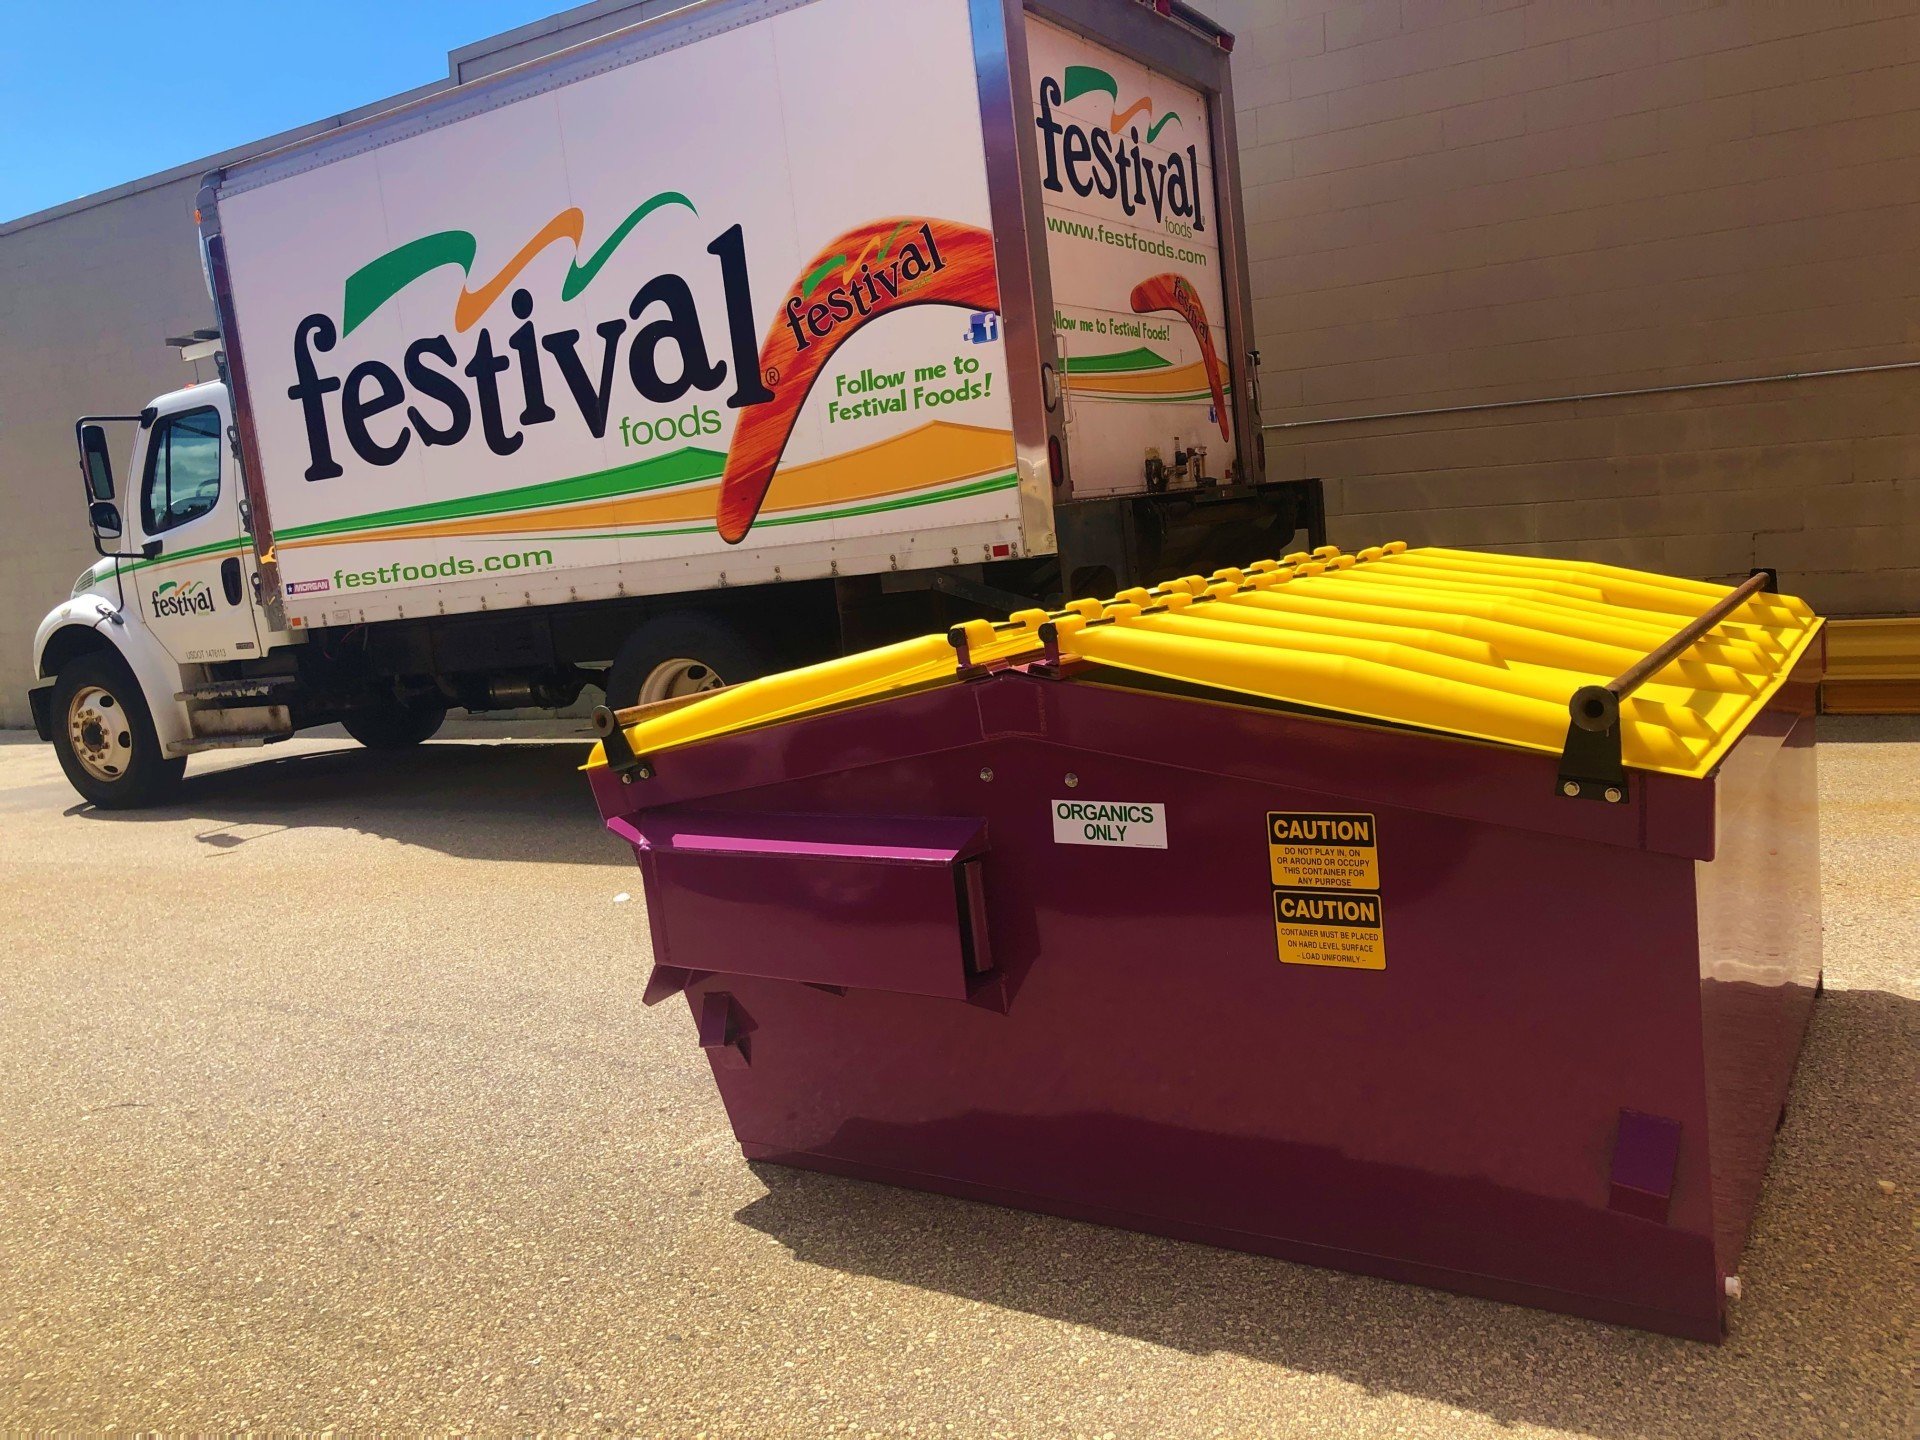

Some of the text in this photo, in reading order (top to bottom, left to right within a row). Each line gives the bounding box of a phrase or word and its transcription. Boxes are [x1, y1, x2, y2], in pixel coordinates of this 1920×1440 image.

[1036, 76, 1204, 232] festival
[1165, 216, 1192, 238] foods
[1047, 217, 1207, 266] www.festfoods.com
[786, 222, 947, 351] festival
[1080, 320, 1093, 332] me
[1096, 318, 1106, 334] to
[1109, 318, 1140, 338] Festival
[1143, 325, 1170, 341] Foods!
[287, 223, 776, 482] festival
[835, 355, 979, 397] Follow me to
[828, 373, 992, 423] Festival Foods!
[619, 405, 722, 447] foods
[334, 549, 553, 589] festfoods.com
[294, 580, 328, 593] MORGAN
[152, 586, 215, 618] festival
[1057, 803, 1154, 823] ORGANICS
[1084, 823, 1127, 841] ONLY
[1273, 819, 1369, 841] CAUTION
[1284, 847, 1296, 855] DO
[1297, 847, 1313, 855] NOT
[1315, 848, 1335, 856] PLAY
[1348, 849, 1360, 857] ON
[1290, 857, 1322, 866] AROUND
[1324, 858, 1336, 866] OR
[1337, 858, 1370, 867] OCCUPY
[1283, 866, 1365, 877] THIS CONTAINER FOR
[1297, 877, 1352, 886] ANY PURPOSE
[1280, 898, 1376, 922] CAUTION
[1280, 928, 1379, 941] CONTAINER MUST BE PLACED
[1287, 940, 1373, 952] ON HARD LEVEL SURFACE
[1302, 952, 1320, 960] LOAD
[1321, 953, 1361, 963] UNIFORMLY
